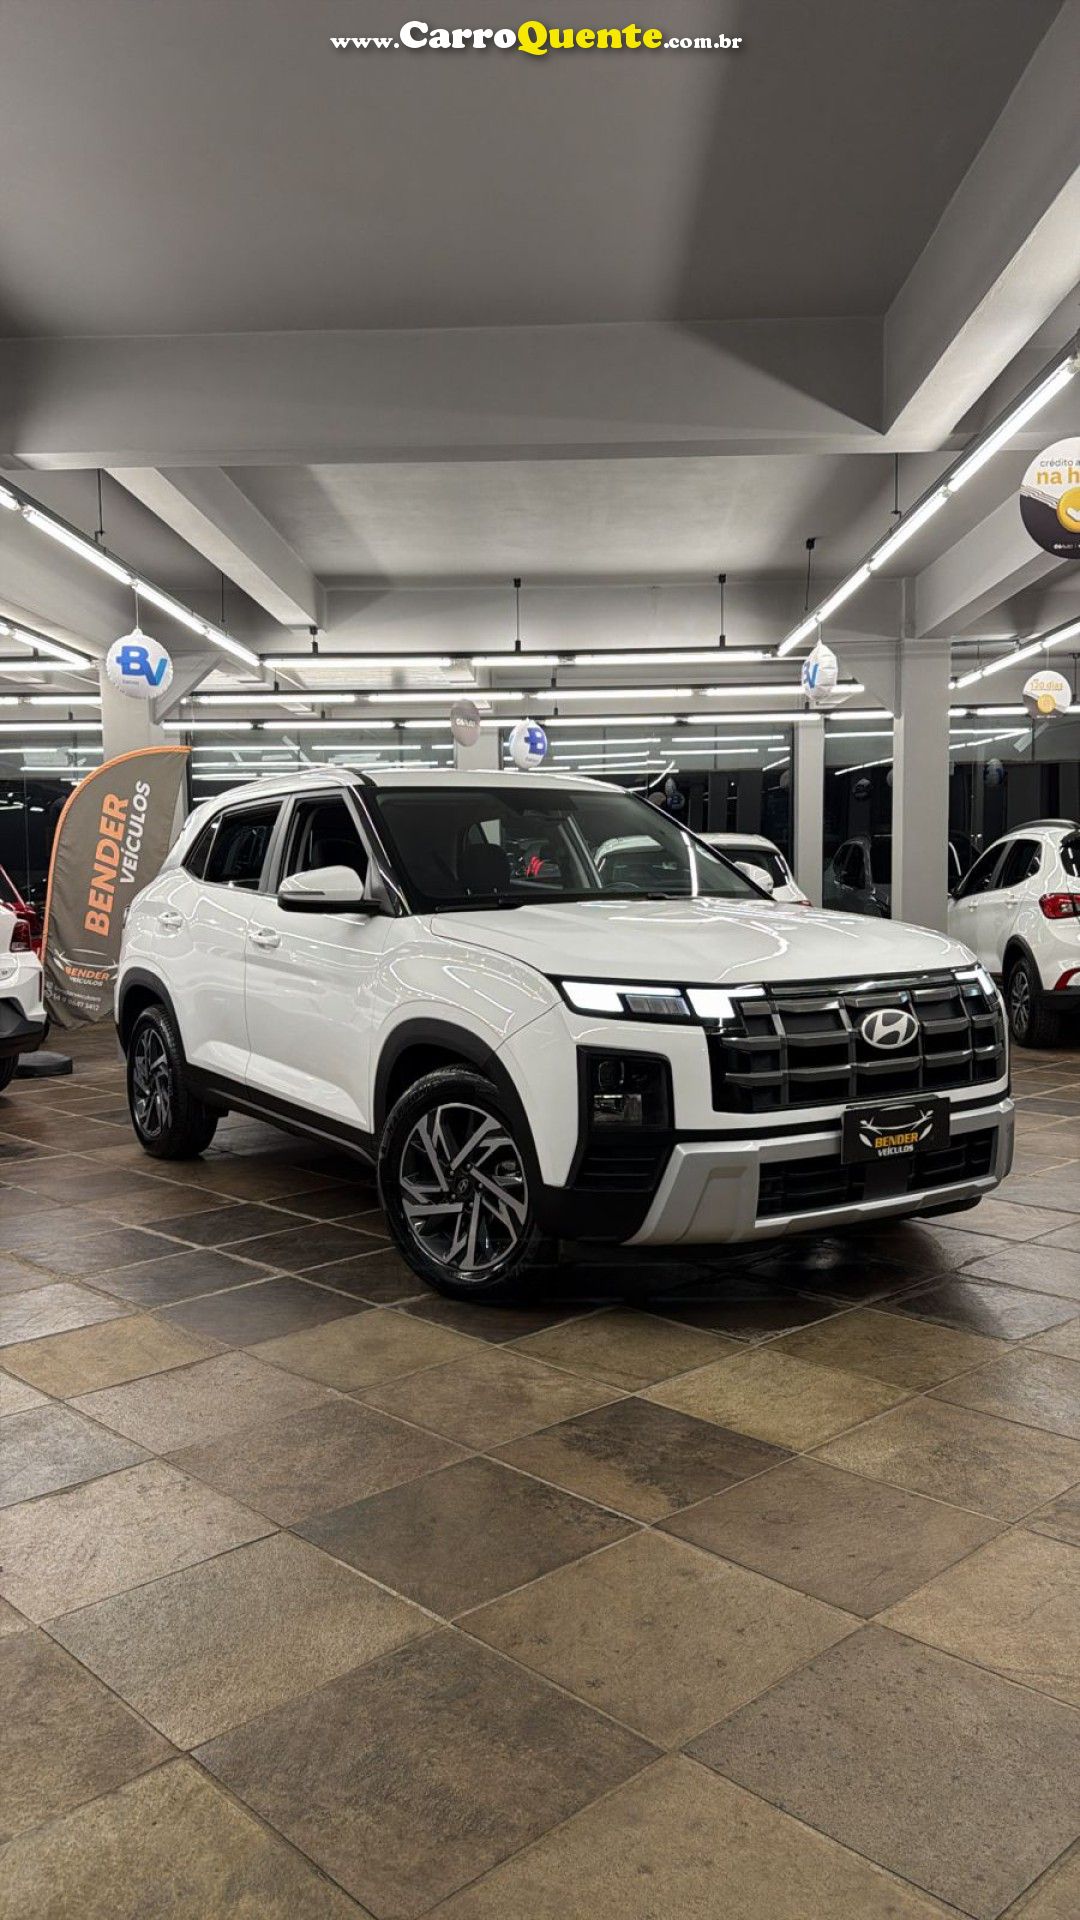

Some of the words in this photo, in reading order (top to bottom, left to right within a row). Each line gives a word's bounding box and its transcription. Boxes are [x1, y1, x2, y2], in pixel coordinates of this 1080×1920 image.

[1037, 470, 1062, 485] na
[116, 645, 168, 687] BV
[119, 780, 151, 885] VEÍCULOS
[84, 793, 130, 937] BENDER
[64, 965, 110, 981] BENDER
[874, 1132, 919, 1149] BENDER
[877, 1144, 915, 1157] VEÍCULOS
